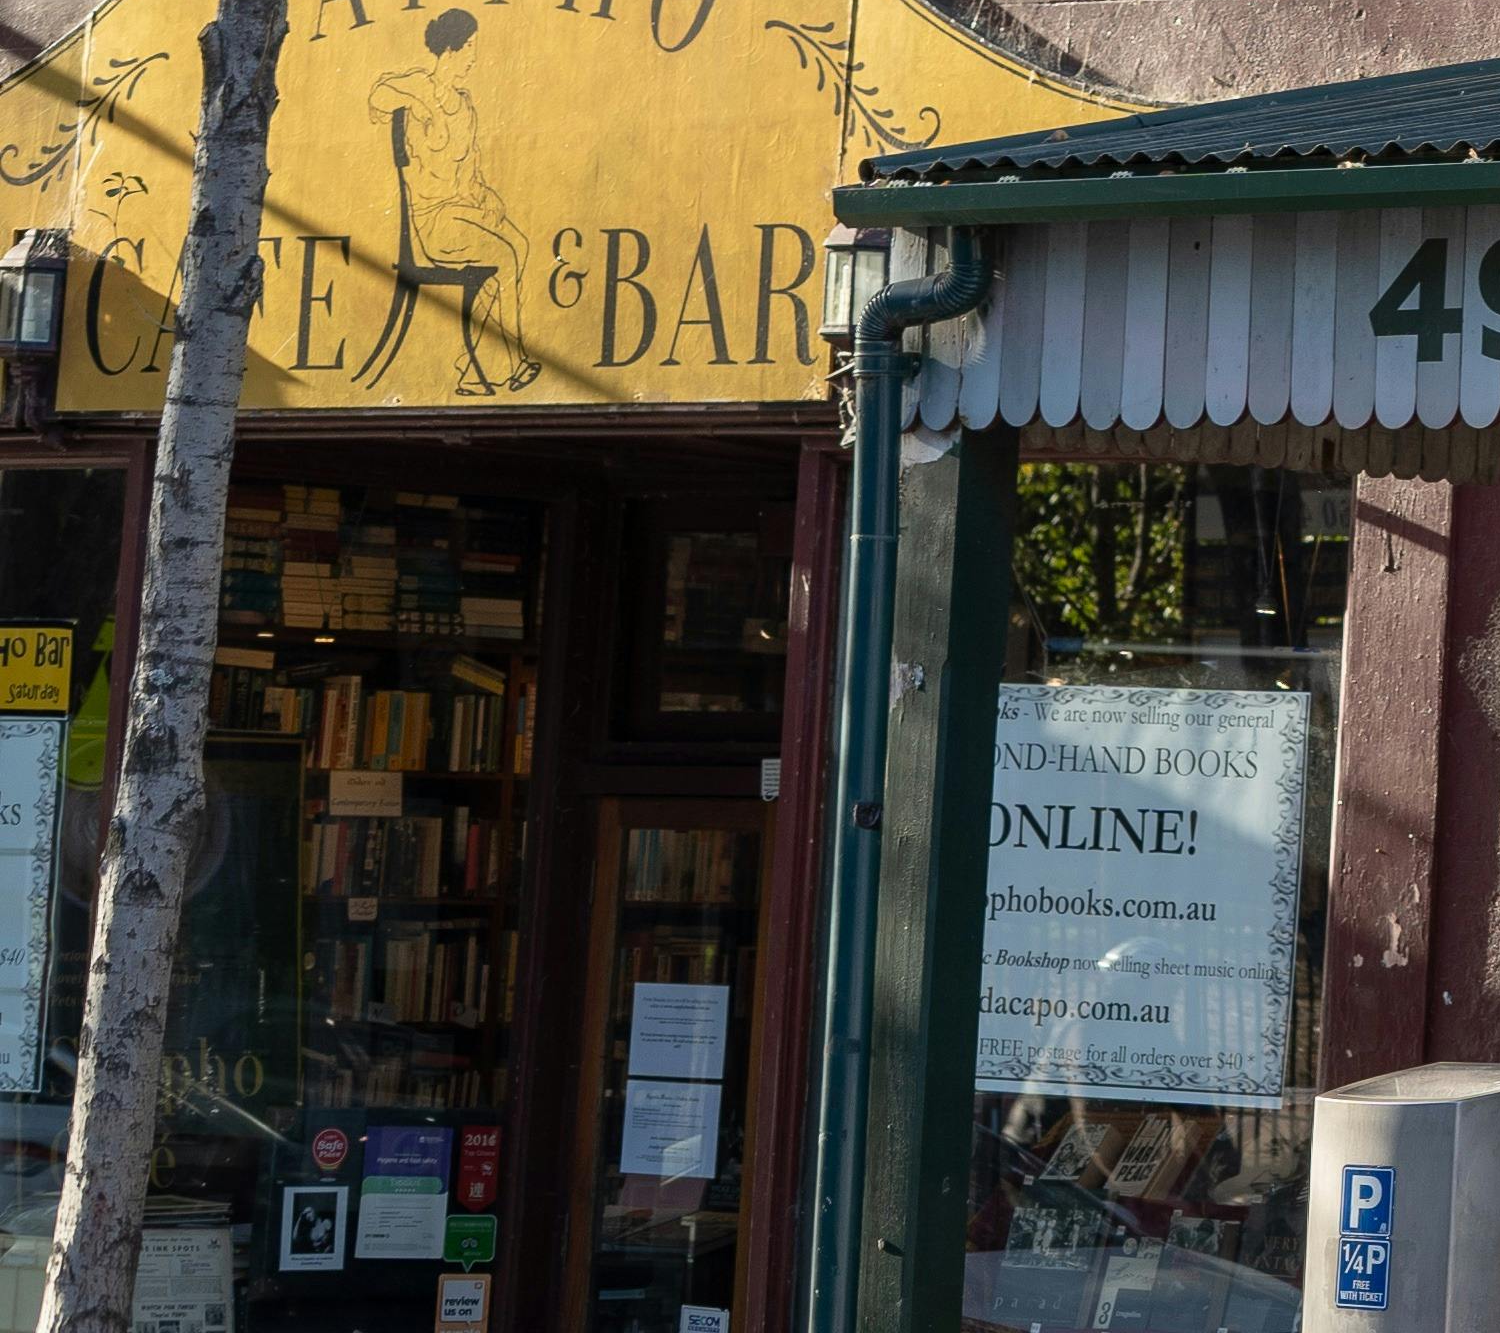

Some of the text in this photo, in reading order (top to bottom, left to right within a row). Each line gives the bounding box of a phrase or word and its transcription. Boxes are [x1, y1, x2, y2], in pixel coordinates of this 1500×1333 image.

[86, 223, 819, 376] CE & BAR
[34, 632, 70, 668] Bar
[5, 683, 60, 704] Saturday
[997, 701, 1275, 734] ks We are now selling our general
[1154, 748, 1258, 781] BOOKS
[984, 886, 1217, 922] phobooks.com.au
[995, 949, 1070, 972] Bookshop
[1154, 959, 1190, 977] sheet
[1193, 963, 1235, 979] music
[979, 987, 1171, 1027] dacapo.com.au
[979, 1037, 1243, 1070] FREE postage for all orders over $40
[317, 1139, 344, 1152] Safe
[464, 1134, 496, 1147] 2016
[1350, 1175, 1383, 1229] P
[1339, 1290, 1383, 1303] WITH TICKET
[1352, 1279, 1371, 1291] FREE
[444, 1297, 480, 1307] review
[444, 1307, 472, 1317] us on
[688, 1314, 721, 1327] SECOM
